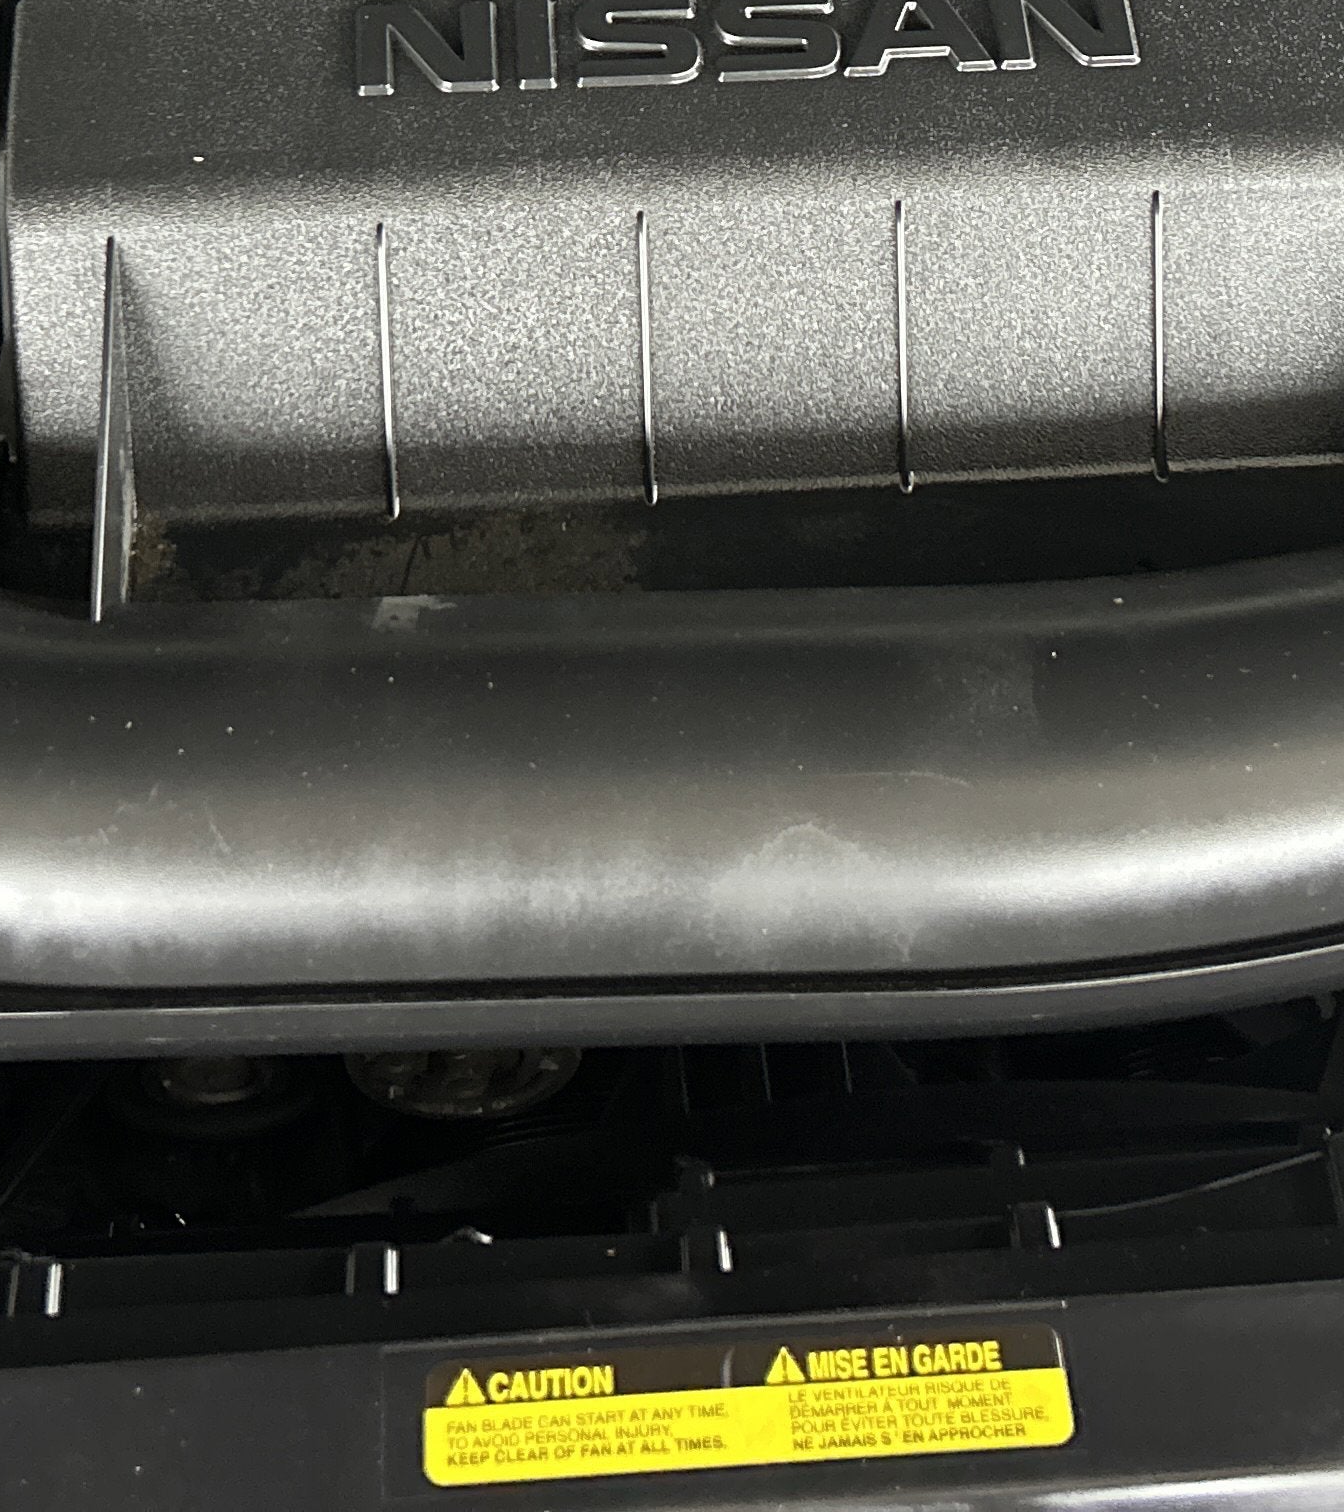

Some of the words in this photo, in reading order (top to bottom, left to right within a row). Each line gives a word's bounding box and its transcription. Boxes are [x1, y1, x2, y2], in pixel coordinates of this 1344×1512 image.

[808, 1348, 869, 1381] MISE
[873, 1346, 909, 1377] EN
[913, 1340, 1002, 1375] GARDE
[488, 1365, 614, 1403] CAUTION
[788, 1389, 806, 1404] LE
[813, 1383, 920, 1402] VENTILATEUR
[924, 1379, 984, 1395] RISQUE
[990, 1378, 1010, 1391] DE
[897, 1397, 937, 1412] TOUT
[948, 1392, 1012, 1409] MOMENT
[447, 1420, 477, 1434] FAN
[482, 1416, 533, 1432] BLADE
[538, 1414, 571, 1428] CAN
[576, 1410, 624, 1426] START
[630, 1408, 647, 1422] AT
[652, 1406, 683, 1420] ANY
[791, 1419, 836, 1435] POUR
[902, 1411, 954, 1428] TOUTE
[448, 1436, 468, 1450] TO
[472, 1433, 520, 1449] AVOID
[524, 1428, 609, 1445] PERSONAL
[792, 1435, 814, 1450] NE
[819, 1432, 877, 1449] JAMAIS
[928, 1423, 1026, 1442] APPROCHER
[447, 1451, 490, 1467] KEEP
[494, 1447, 548, 1464] CLEAR
[554, 1445, 575, 1460] OF
[580, 1443, 612, 1457] FAN
[616, 1440, 636, 1455] AT
[640, 1438, 670, 1454] ALL
